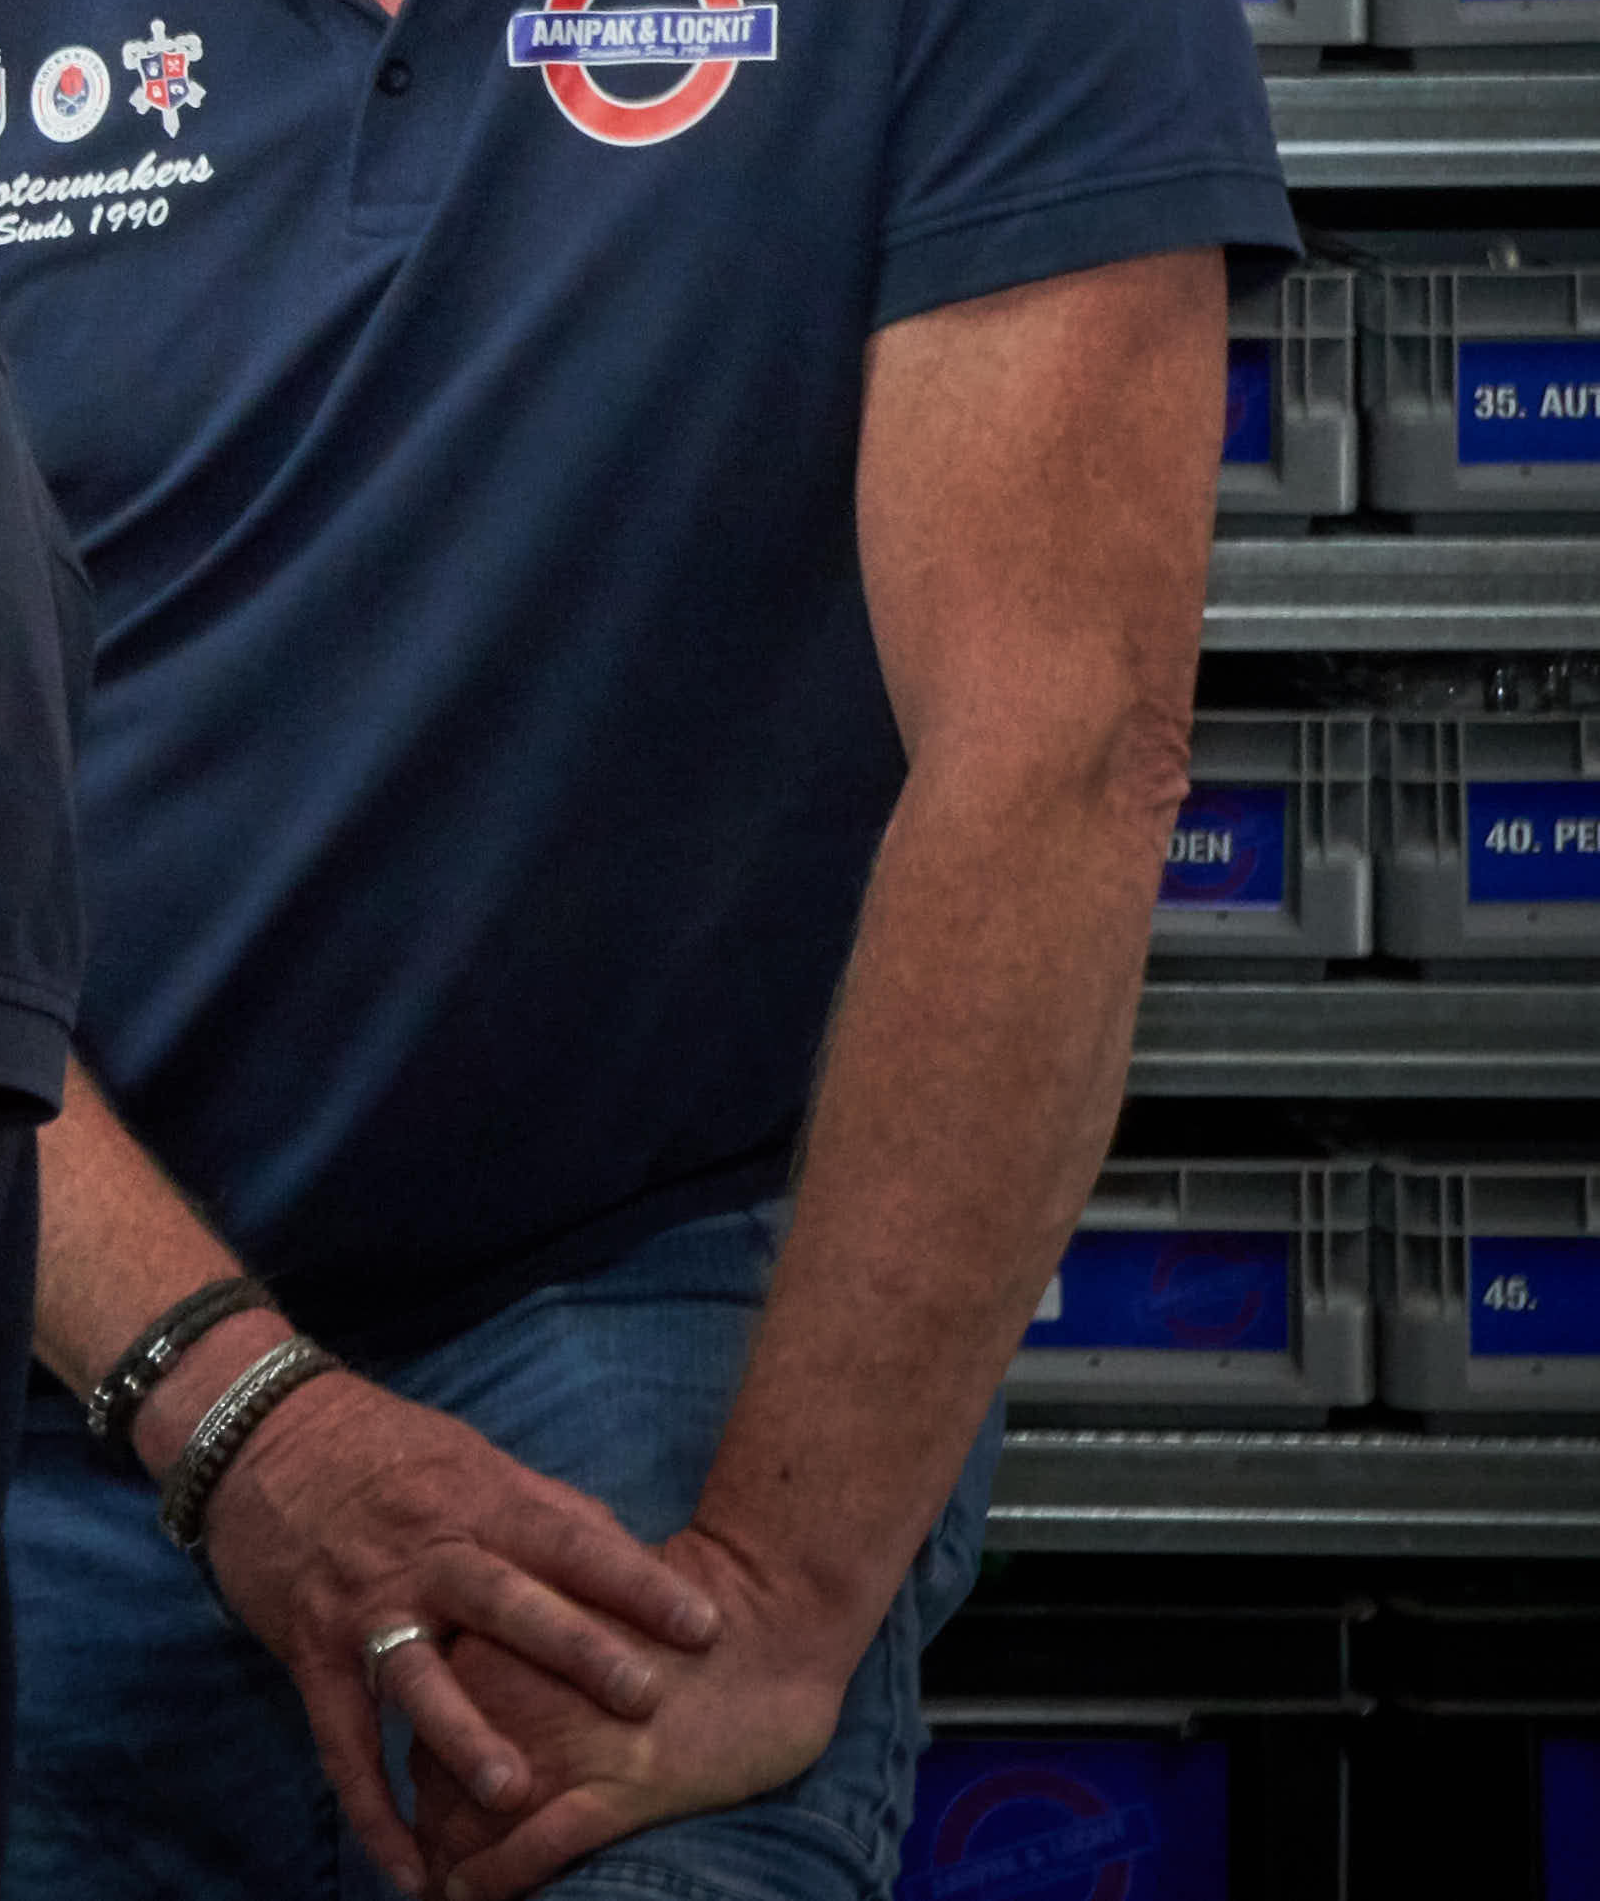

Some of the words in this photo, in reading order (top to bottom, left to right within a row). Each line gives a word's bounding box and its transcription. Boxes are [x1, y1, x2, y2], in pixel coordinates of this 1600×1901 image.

[531, 18, 636, 47] AANPAK
[637, 15, 658, 45] &
[661, 13, 755, 44] LOCKIT
[88, 196, 169, 235] 1990
[1473, 385, 1527, 421] 35.
[1484, 819, 1541, 854] 40.
[1553, 818, 1600, 854] PE
[1482, 1274, 1537, 1309] 45.
